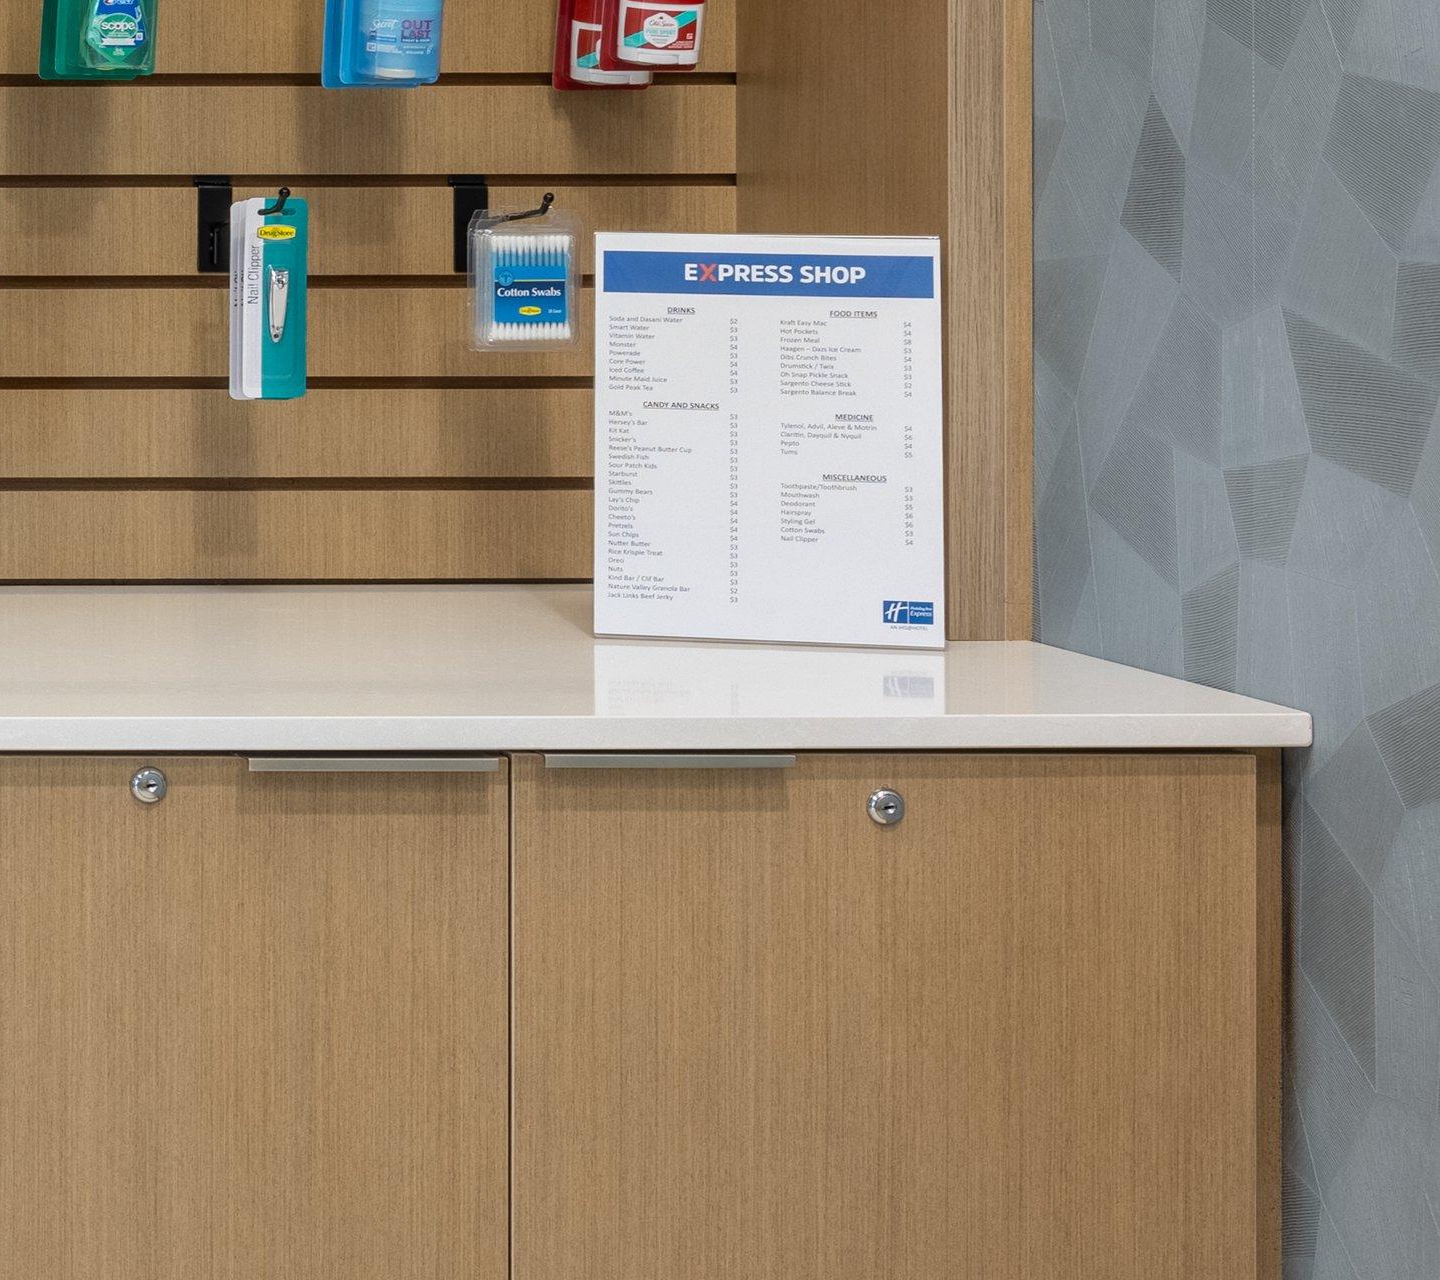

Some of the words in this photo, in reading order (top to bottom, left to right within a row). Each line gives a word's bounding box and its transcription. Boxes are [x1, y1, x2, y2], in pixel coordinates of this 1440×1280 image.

[101, 20, 137, 33] scope
[401, 20, 432, 30] OUT
[247, 244, 261, 280] Clipper
[685, 263, 793, 283] EXPRESS
[800, 266, 866, 285] SHOP
[247, 281, 259, 305] Nail
[497, 288, 530, 297] Cotton
[532, 287, 561, 297] Swabs
[823, 474, 887, 483] MISCELLANEOUS
[781, 483, 857, 491] Toothpaste/Toothbrush
